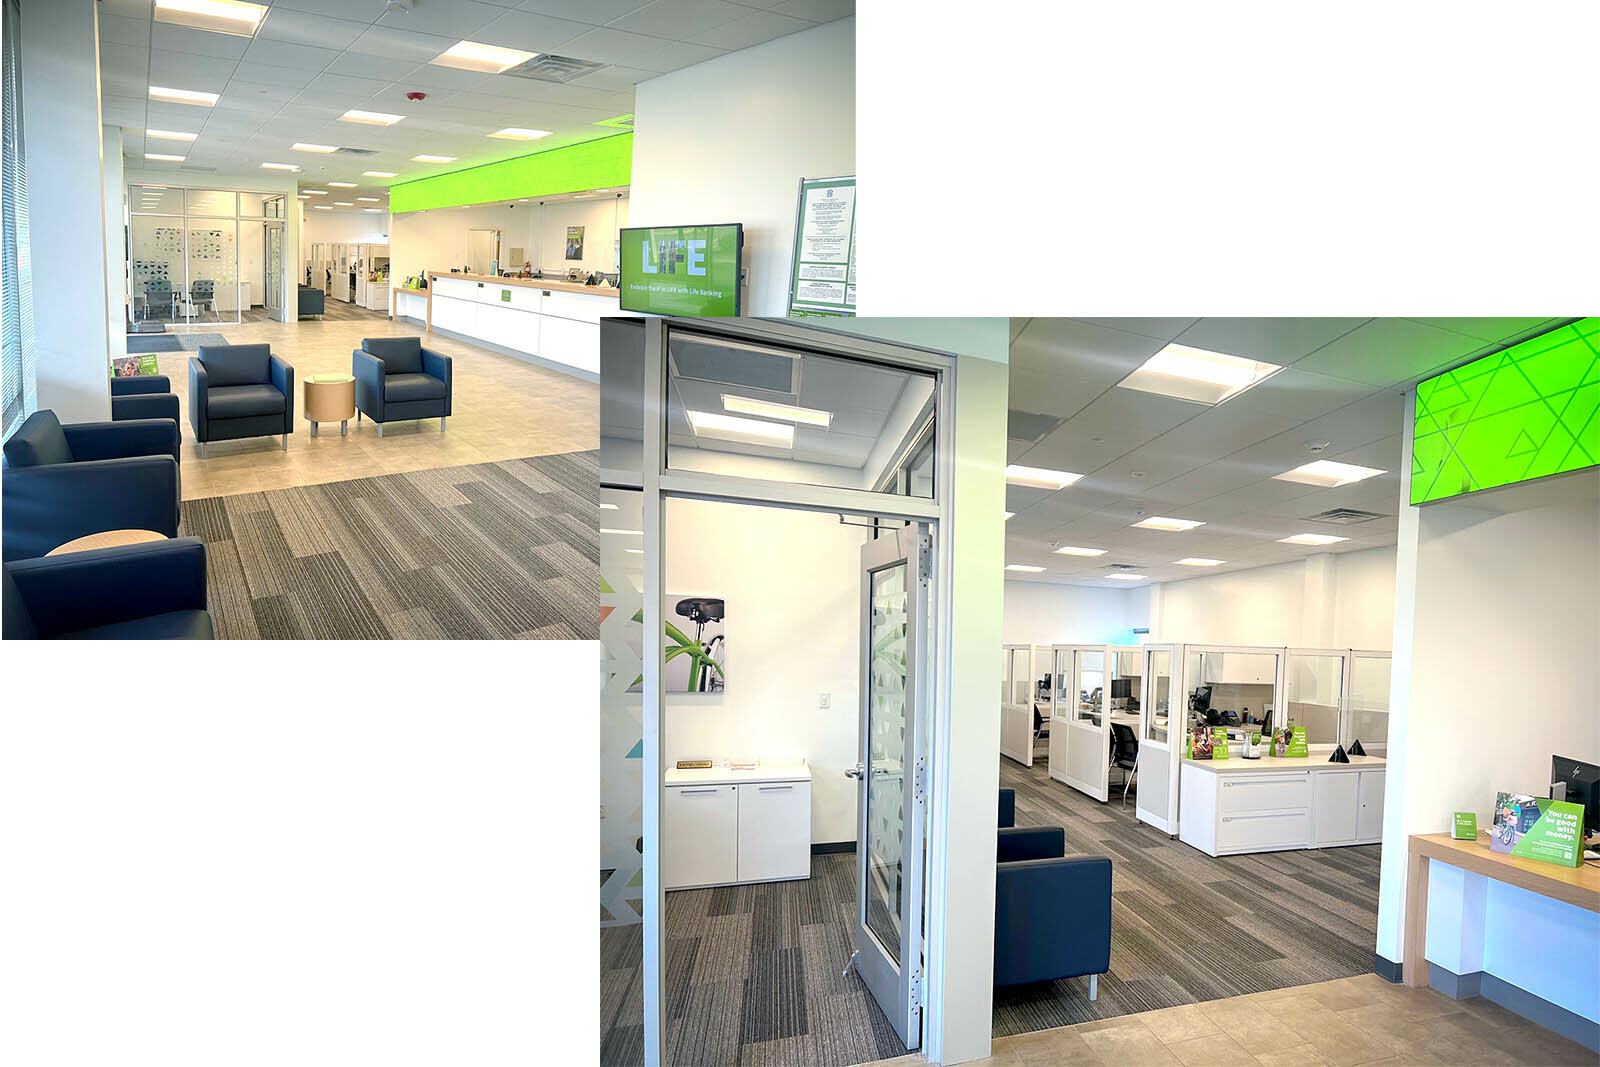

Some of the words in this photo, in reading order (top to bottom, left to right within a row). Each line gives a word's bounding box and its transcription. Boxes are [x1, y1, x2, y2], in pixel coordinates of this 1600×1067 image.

[642, 239, 706, 276] LIFE
[1545, 815, 1555, 823] be
[1556, 819, 1577, 827] good
[1556, 826, 1576, 834] with
